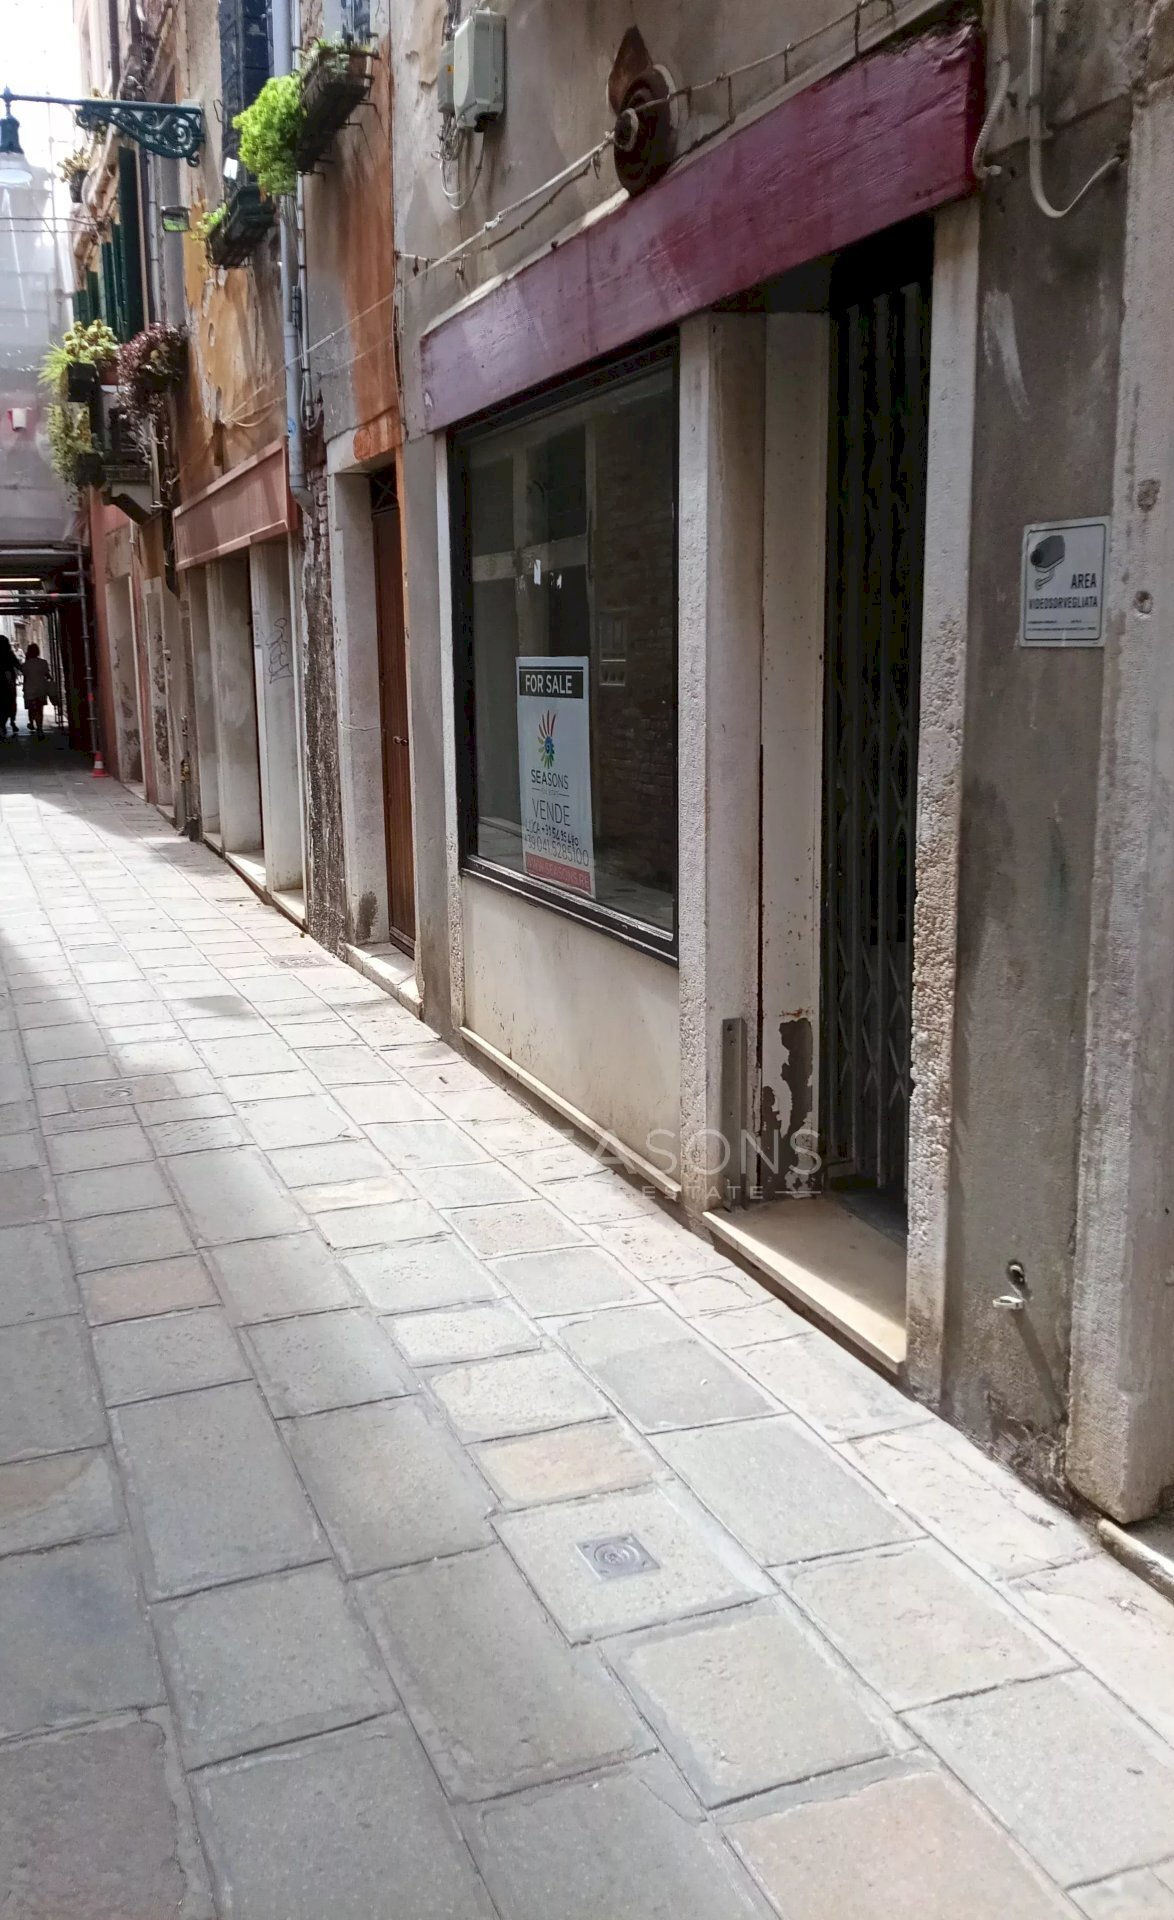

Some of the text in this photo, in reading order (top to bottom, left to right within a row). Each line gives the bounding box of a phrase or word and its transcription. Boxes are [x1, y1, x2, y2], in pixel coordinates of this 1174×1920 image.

[1070, 573, 1097, 589] AREA
[525, 674, 573, 694] FOR SALE
[530, 769, 569, 790] SEASONS
[532, 798, 571, 827] VENDE
